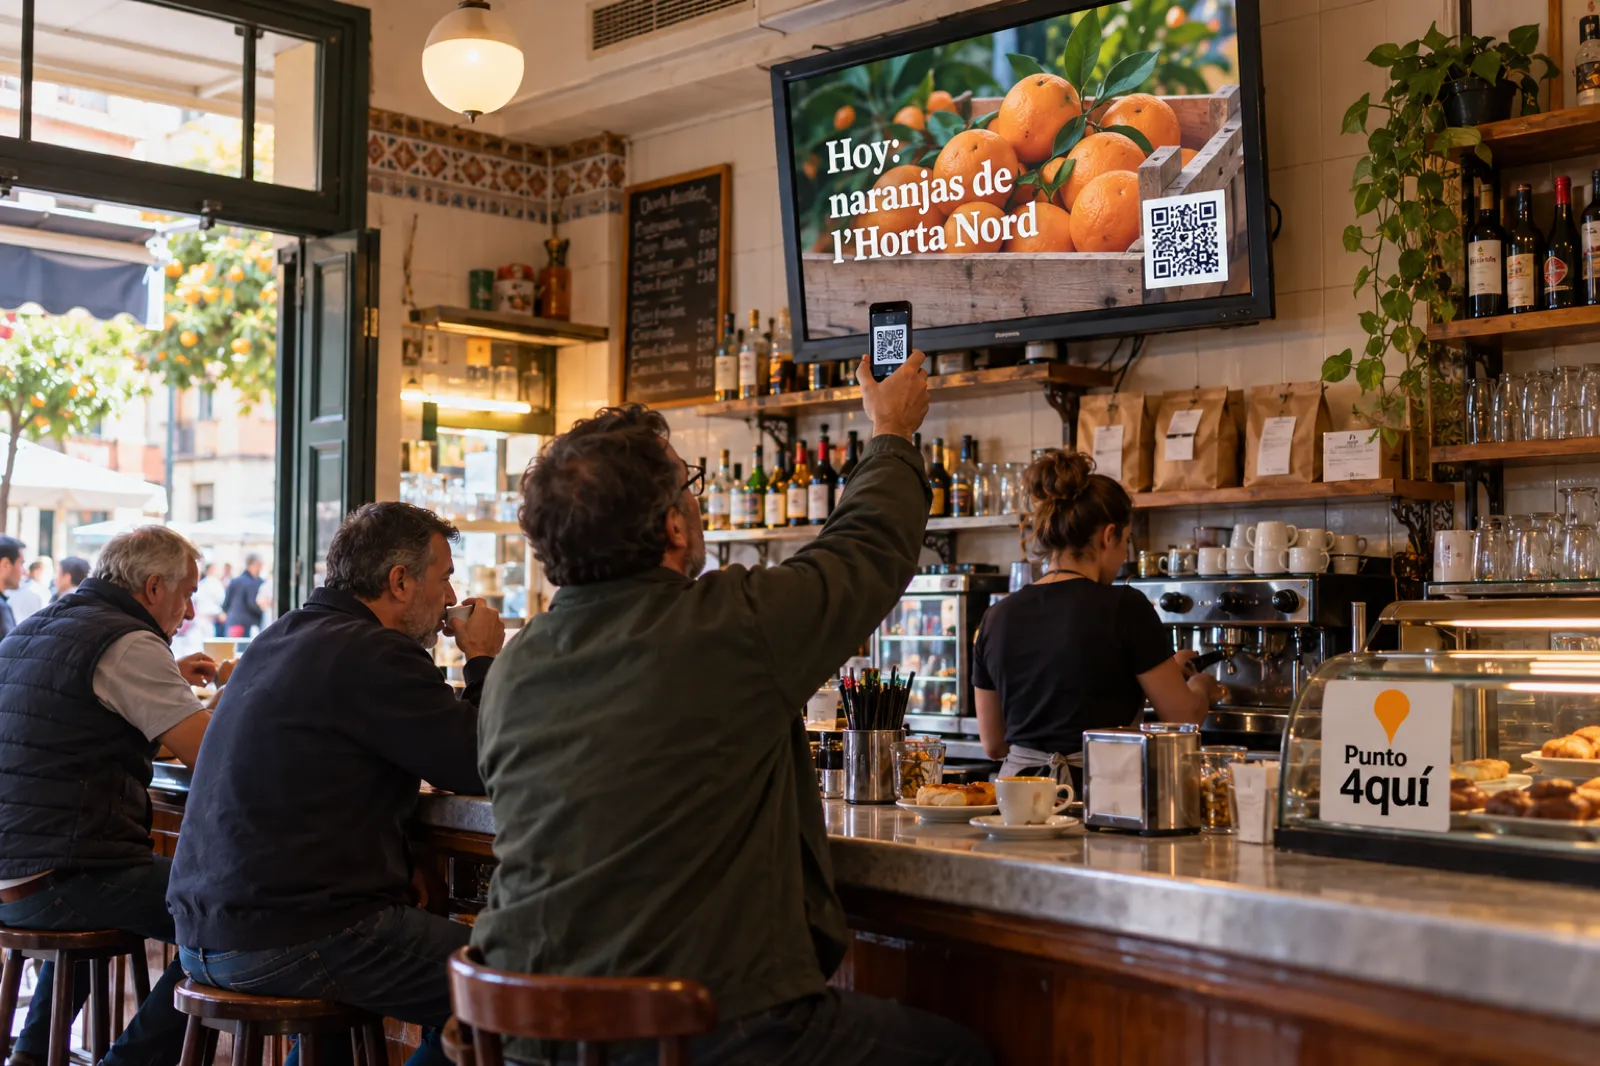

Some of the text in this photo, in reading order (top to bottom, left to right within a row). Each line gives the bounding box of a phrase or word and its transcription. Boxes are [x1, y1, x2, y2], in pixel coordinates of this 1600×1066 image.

[826, 137, 900, 175] Hoy:
[829, 159, 1012, 218] naranjas de
[831, 200, 1039, 264] l’Horta Nord
[1344, 744, 1407, 767] Punto
[1340, 765, 1434, 816] 4quí
